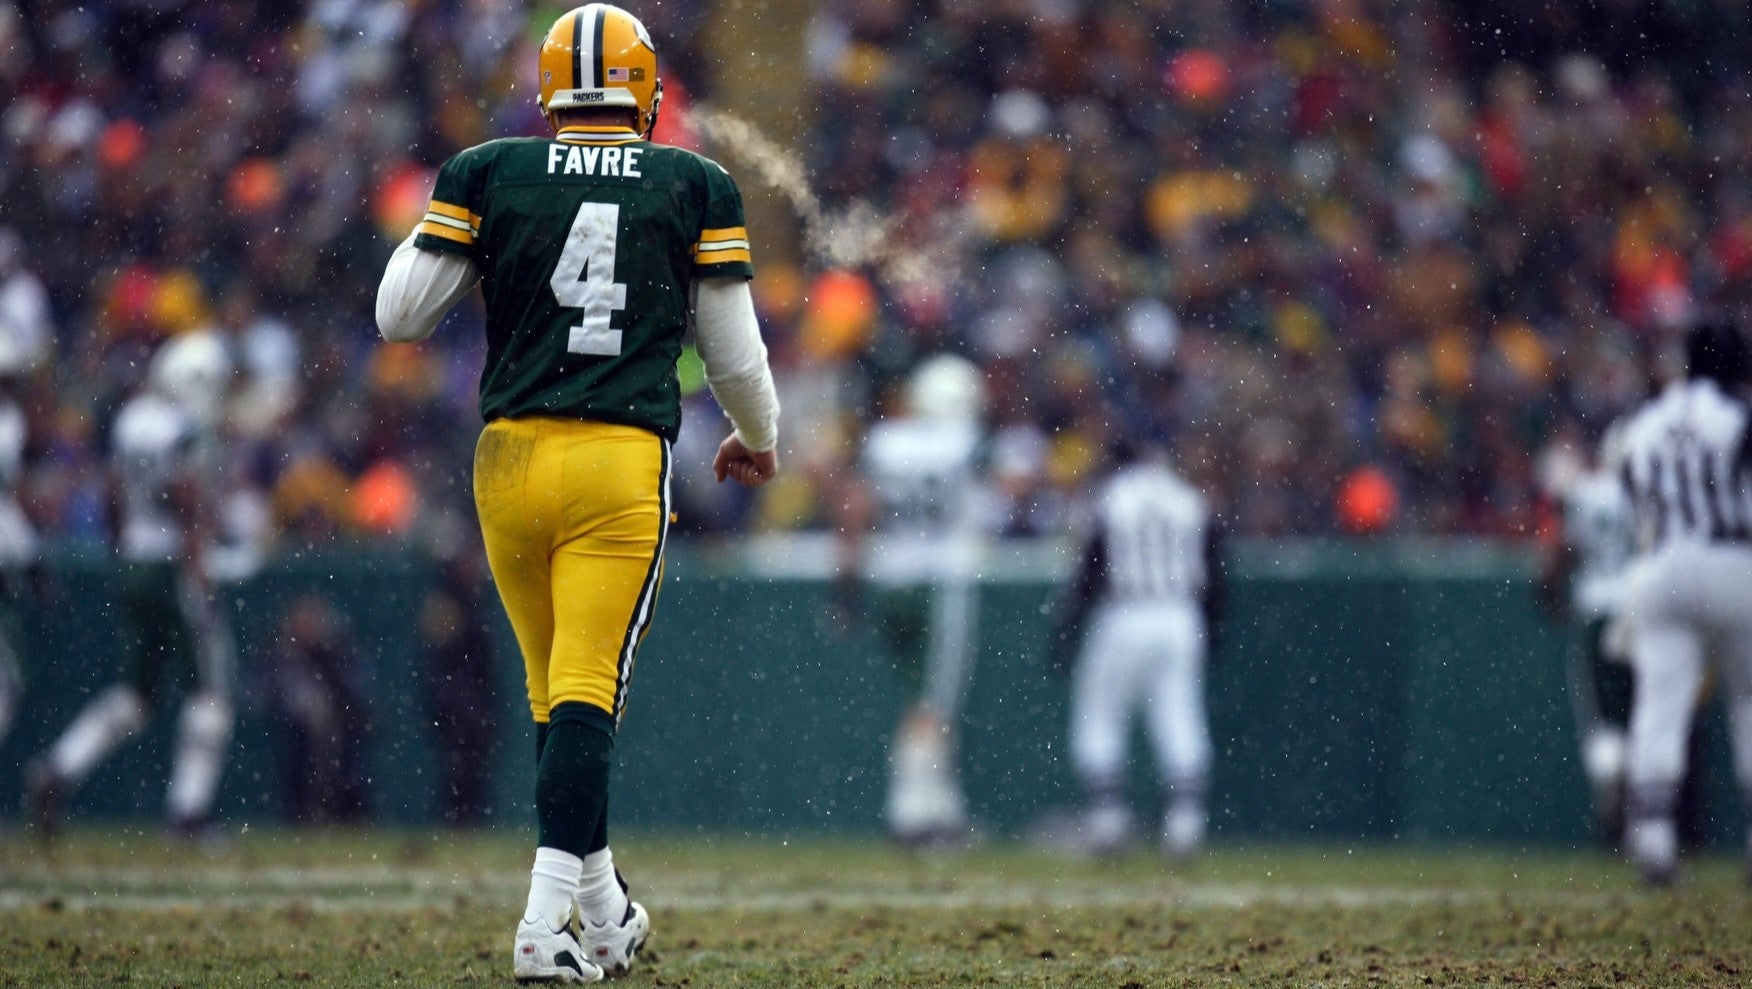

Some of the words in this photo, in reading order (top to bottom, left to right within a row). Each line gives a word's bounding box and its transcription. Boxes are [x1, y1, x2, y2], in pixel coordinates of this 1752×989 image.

[572, 92, 604, 103] PACKERS
[547, 143, 643, 178] FAVRE
[550, 202, 627, 356] 4
